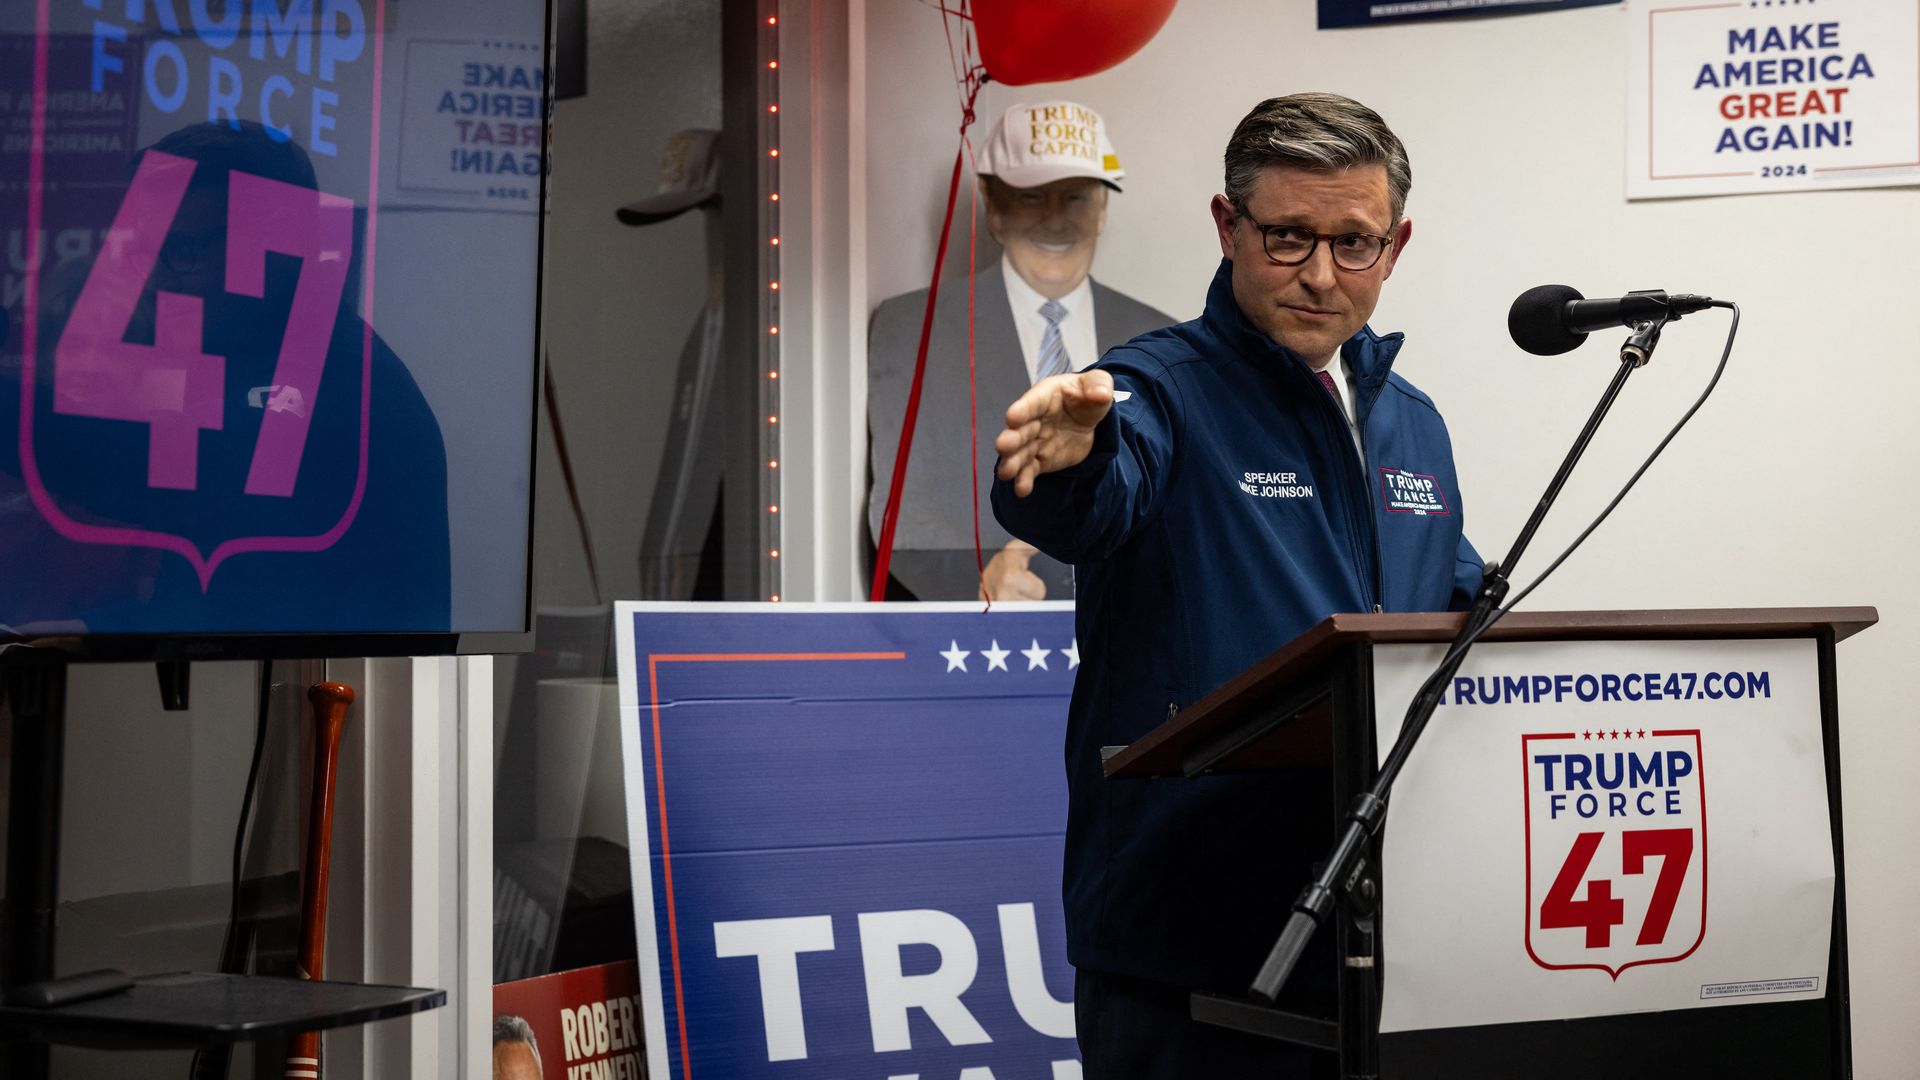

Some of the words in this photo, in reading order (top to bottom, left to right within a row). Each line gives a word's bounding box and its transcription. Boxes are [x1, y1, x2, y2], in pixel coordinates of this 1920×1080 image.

[1728, 22, 1840, 54] MAKE
[1694, 53, 1874, 89] AMERICA
[91, 20, 339, 157] FORCE
[1719, 88, 1849, 120] GREAT
[1025, 103, 1097, 127] TRUMP
[1715, 121, 1852, 153] AGAIN!
[1761, 165, 1807, 177] 2024
[53, 149, 353, 497] 47
[1244, 472, 1296, 484] SPEAKER
[1260, 486, 1313, 498] JOHNSON
[1386, 474, 1433, 492] TRUMP
[1394, 489, 1436, 503] VANCE
[1440, 671, 1771, 705] RUMPFORCE47.COM
[1534, 751, 1693, 791] TRUMP
[1550, 790, 1682, 819] FORCE
[1540, 828, 1694, 948] 47
